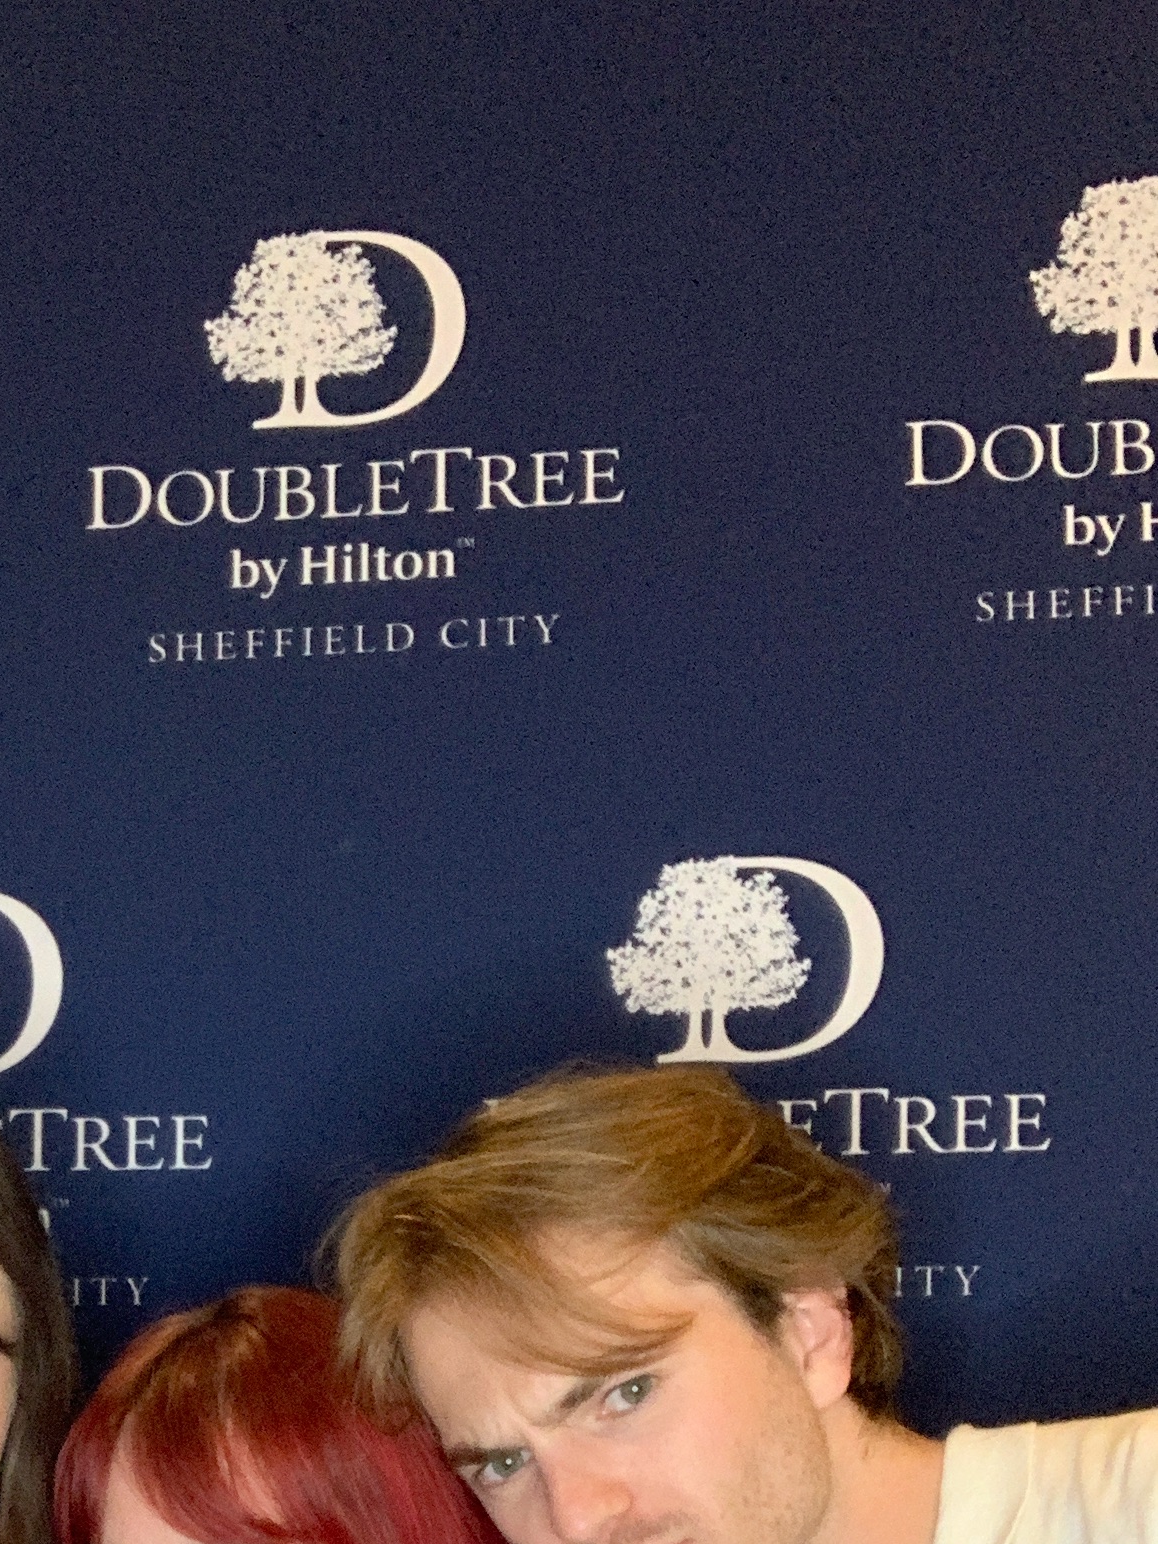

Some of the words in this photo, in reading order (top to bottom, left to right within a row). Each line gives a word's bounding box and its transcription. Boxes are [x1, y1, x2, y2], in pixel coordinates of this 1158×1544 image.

[85, 448, 626, 530] DOUBLETREE
[1063, 504, 1126, 556] by
[229, 548, 288, 600] by
[975, 583, 1158, 622] SHEFFI
[148, 621, 416, 663] SHEFFIELD
[441, 613, 561, 650] CITY
[775, 1087, 1053, 1156] ETREE
[73, 1277, 149, 1306] ITY
[893, 1264, 981, 1297] ITY
